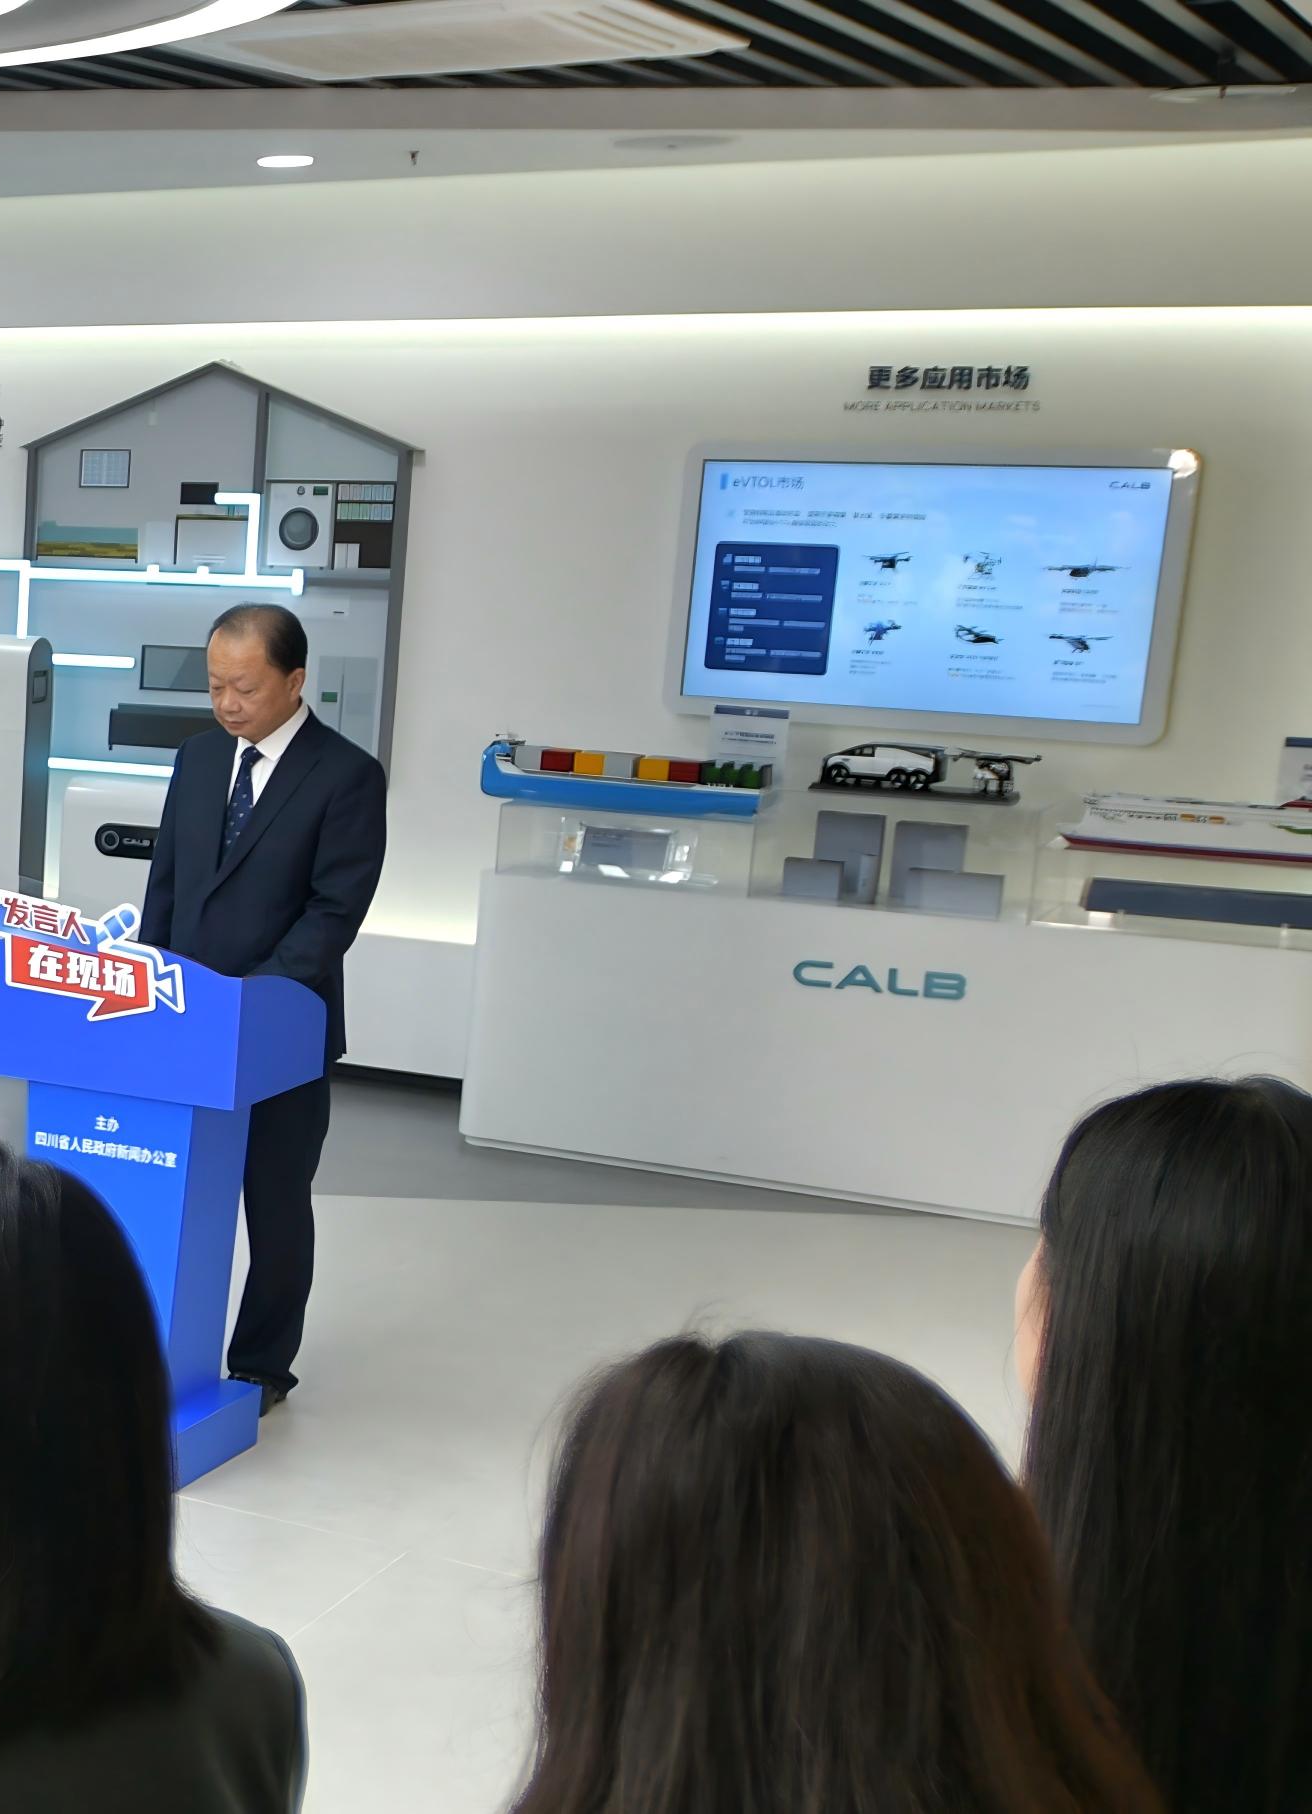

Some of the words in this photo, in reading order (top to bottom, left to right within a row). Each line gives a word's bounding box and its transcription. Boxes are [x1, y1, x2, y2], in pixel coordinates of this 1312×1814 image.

[867, 365, 1030, 390] 更多应用市场
[4, 897, 88, 943] 发言人
[28, 945, 136, 998] 在现场
[792, 959, 968, 1001] CALB
[94, 1115, 120, 1133] 主办
[35, 1131, 177, 1168] 四川省人民政府新闻办公室
